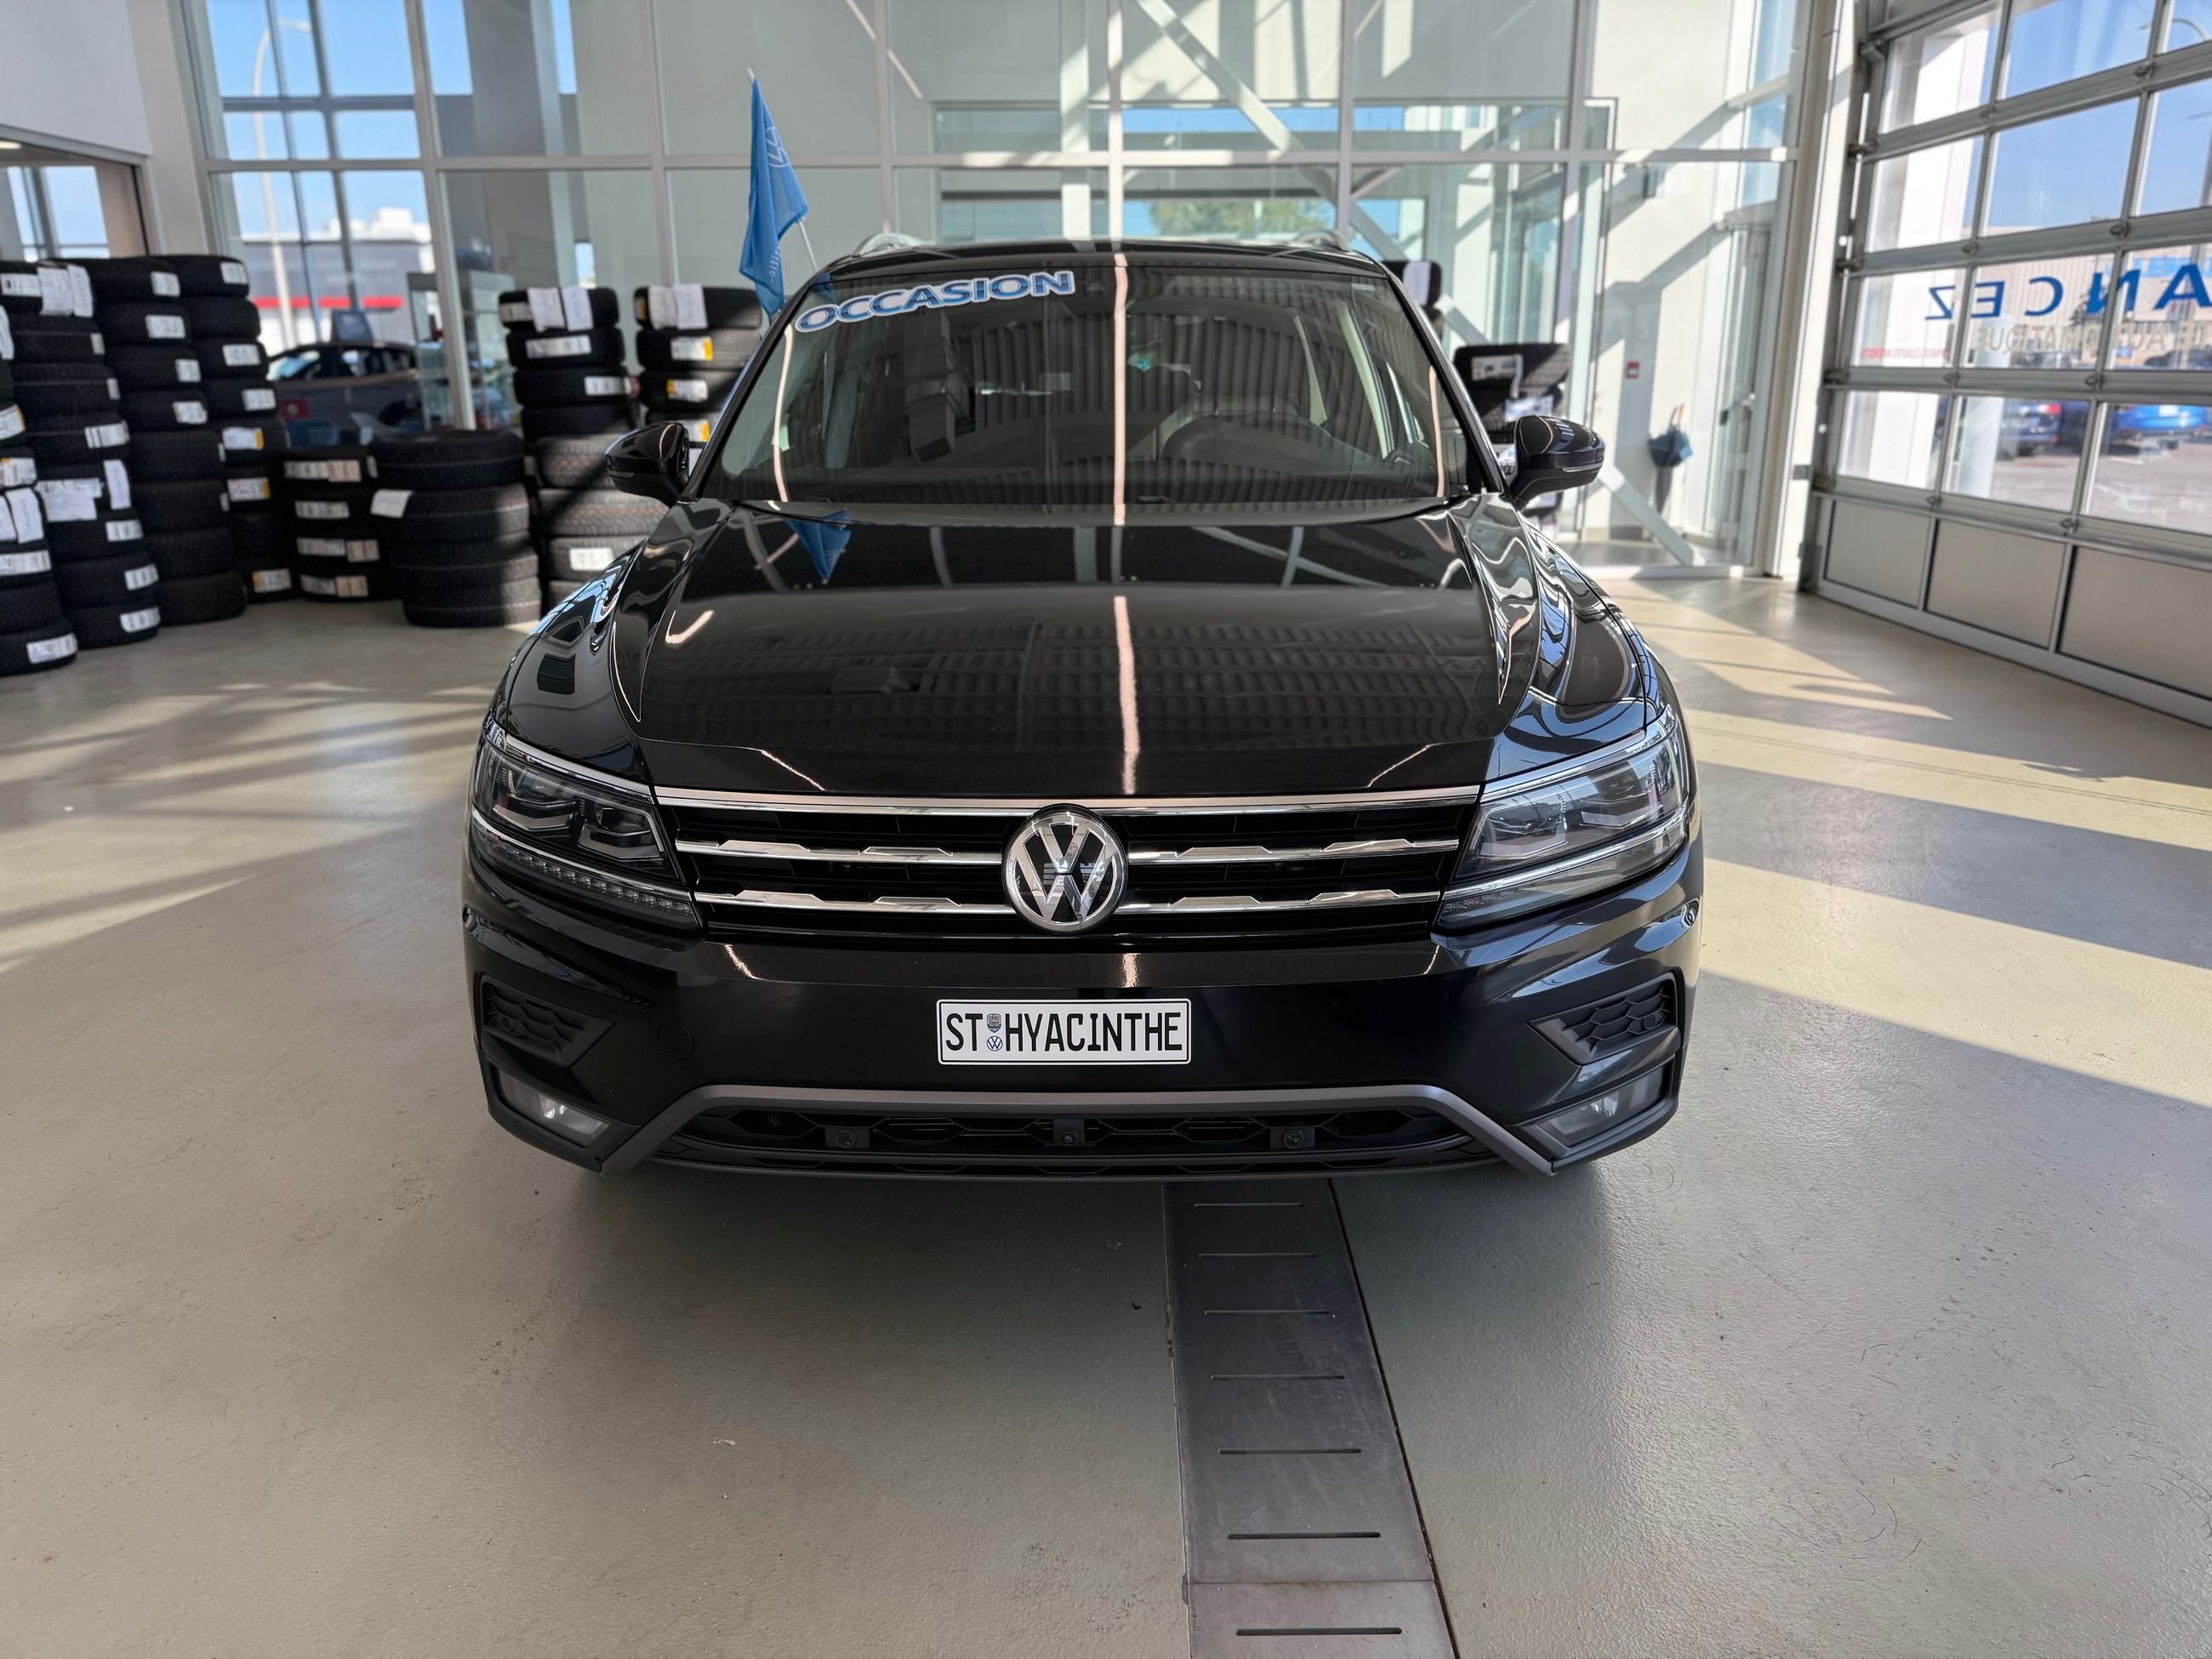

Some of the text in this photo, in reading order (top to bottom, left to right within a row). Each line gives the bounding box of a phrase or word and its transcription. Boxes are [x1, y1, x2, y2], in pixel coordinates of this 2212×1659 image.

[795, 271, 1075, 333] OCCASION
[946, 1012, 1183, 1052] ST HYACINTHE
